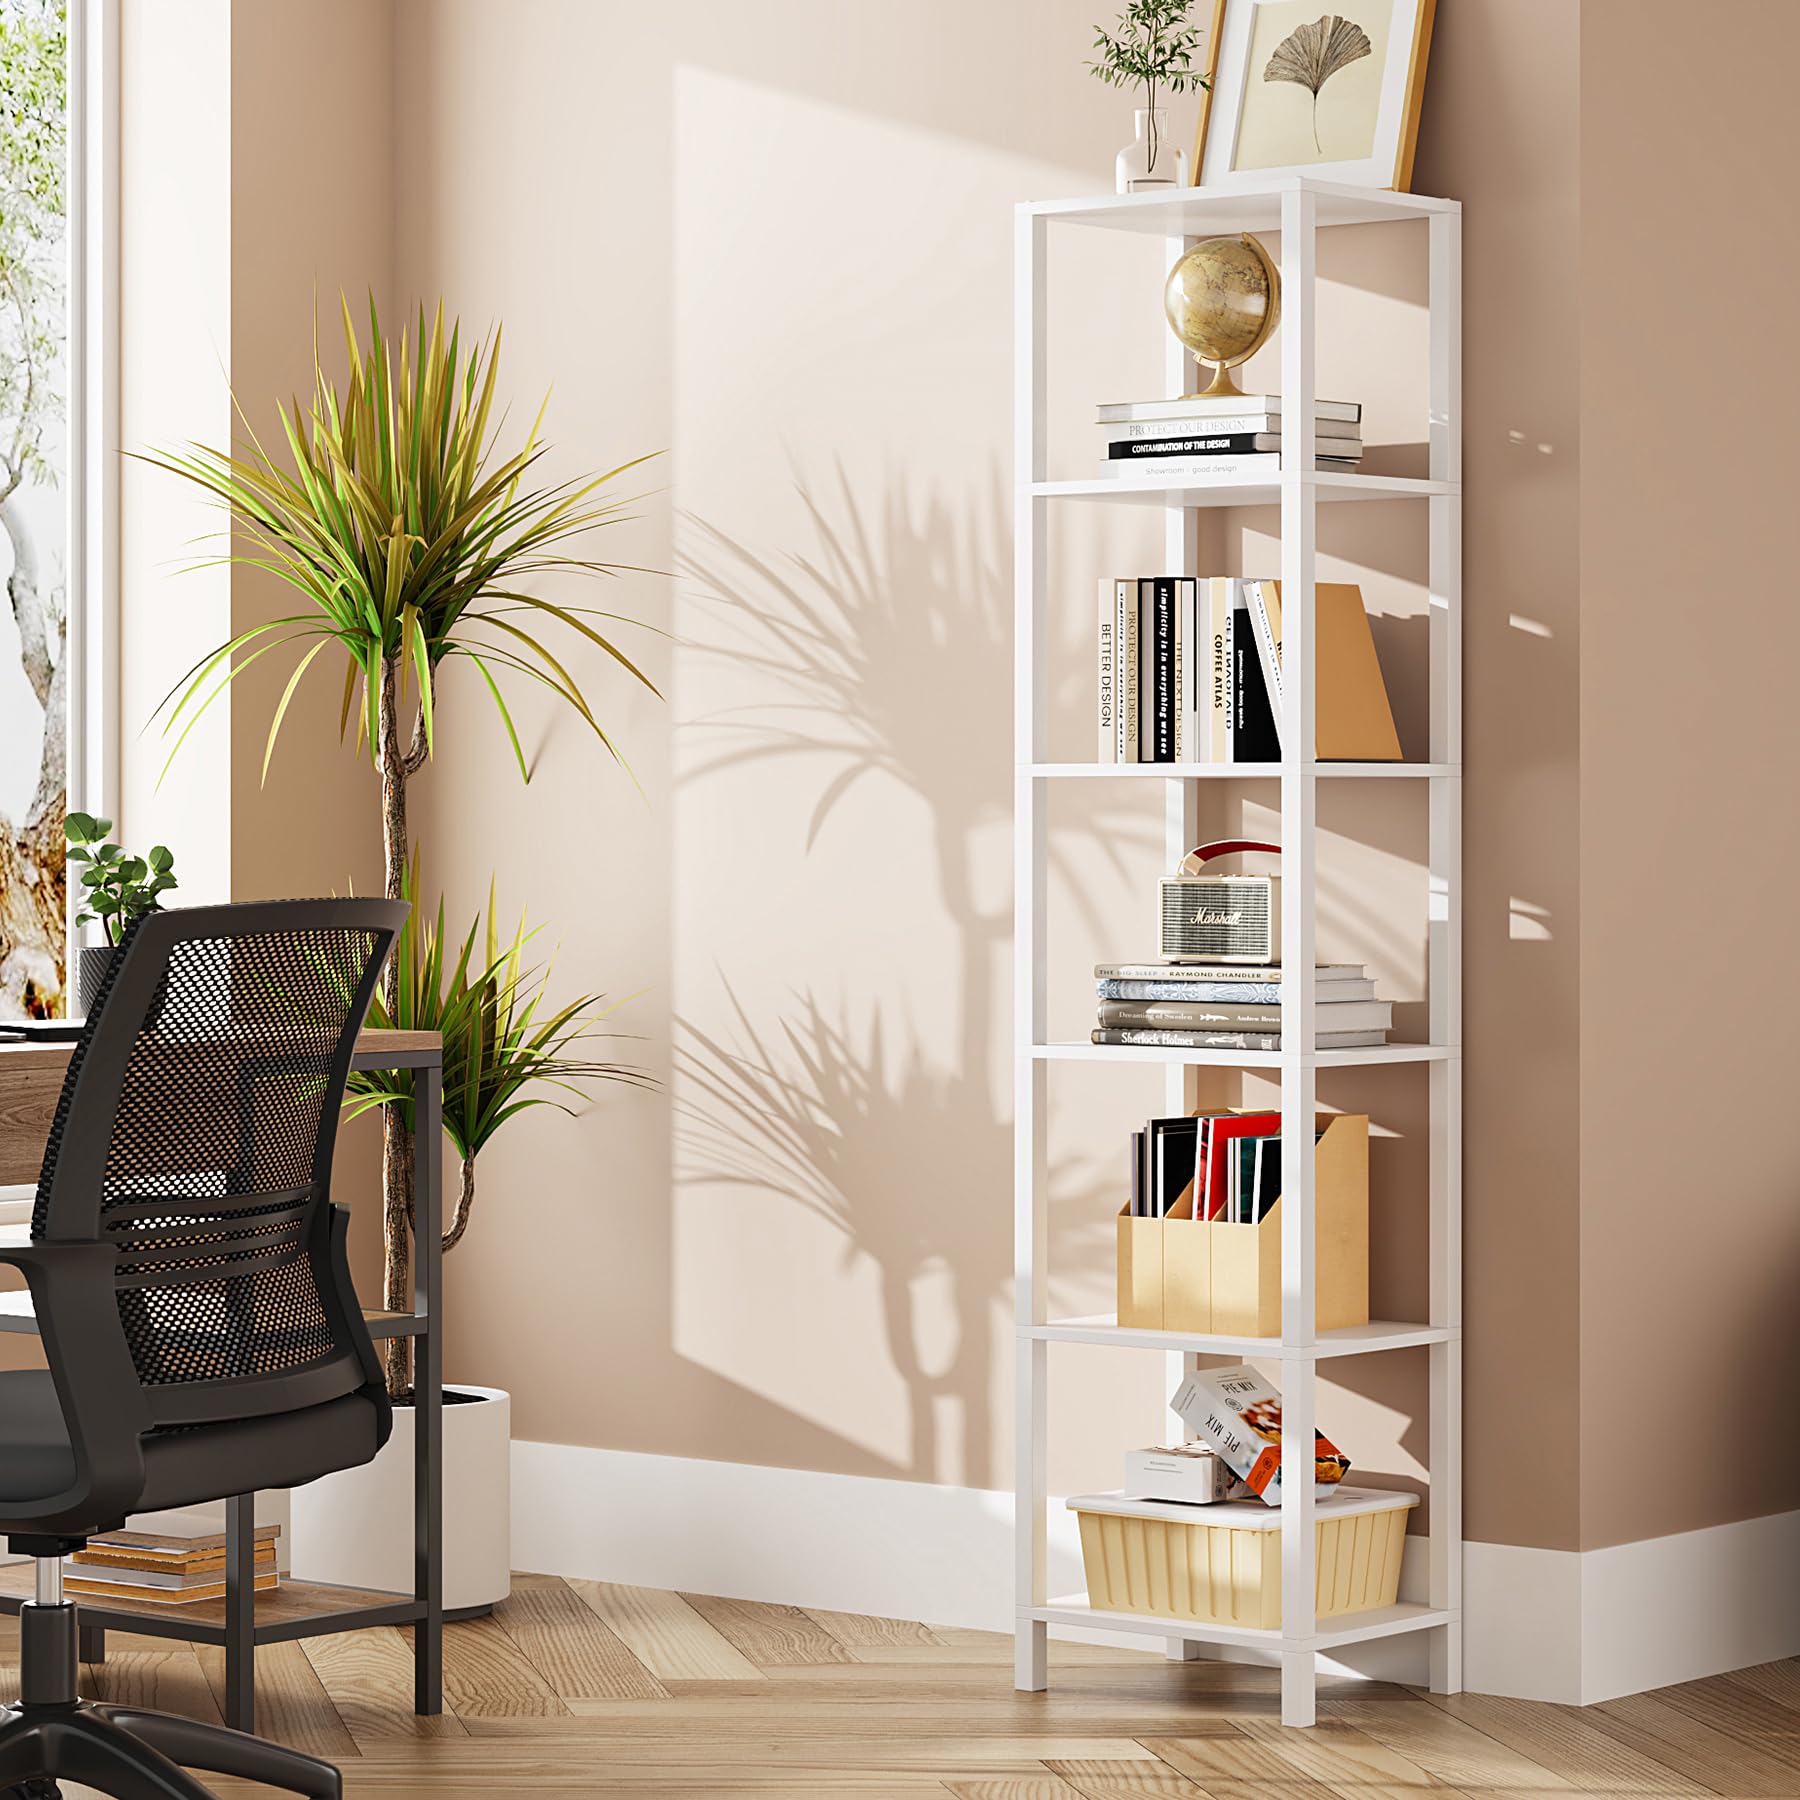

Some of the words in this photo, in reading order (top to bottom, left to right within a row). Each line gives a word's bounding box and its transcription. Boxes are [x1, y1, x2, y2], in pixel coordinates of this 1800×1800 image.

[1129, 424, 1176, 436] PROTECT
[1179, 421, 1205, 433] OUR
[1206, 419, 1245, 431] DESIGN
[1184, 441, 1194, 450] OF
[1194, 440, 1205, 450] THE
[1206, 439, 1231, 449] DESIGN
[1146, 467, 1185, 475] Showroom
[1192, 465, 1211, 474] good
[1213, 464, 1237, 473] design
[1159, 587, 1168, 637] simplicity
[1102, 624, 1111, 671] BETTER
[1128, 611, 1137, 666] PROTECT
[1160, 641, 1168, 649] is
[1160, 652, 1168, 662] in
[1215, 634, 1223, 673] COFFEE
[1128, 668, 1137, 695] OUR
[1159, 665, 1168, 719] everything
[1215, 676, 1223, 709] ATLAS
[1102, 676, 1111, 727] DESIGN
[1128, 698, 1137, 742] DESIGN
[1160, 721, 1167, 734] we
[1190, 907, 1242, 925] Marshall
[1119, 1011, 1154, 1020] Dreaming
[1155, 1012, 1164, 1020] of
[1164, 1013, 1193, 1021] Sweden
[1121, 1032, 1160, 1045] Sherlock
[1162, 1034, 1194, 1046] Holmes
[1221, 1384, 1240, 1394] PIE
[1236, 1381, 1258, 1392] MIX
[1205, 1413, 1225, 1437] MIX
[1223, 1431, 1241, 1453] PIE
